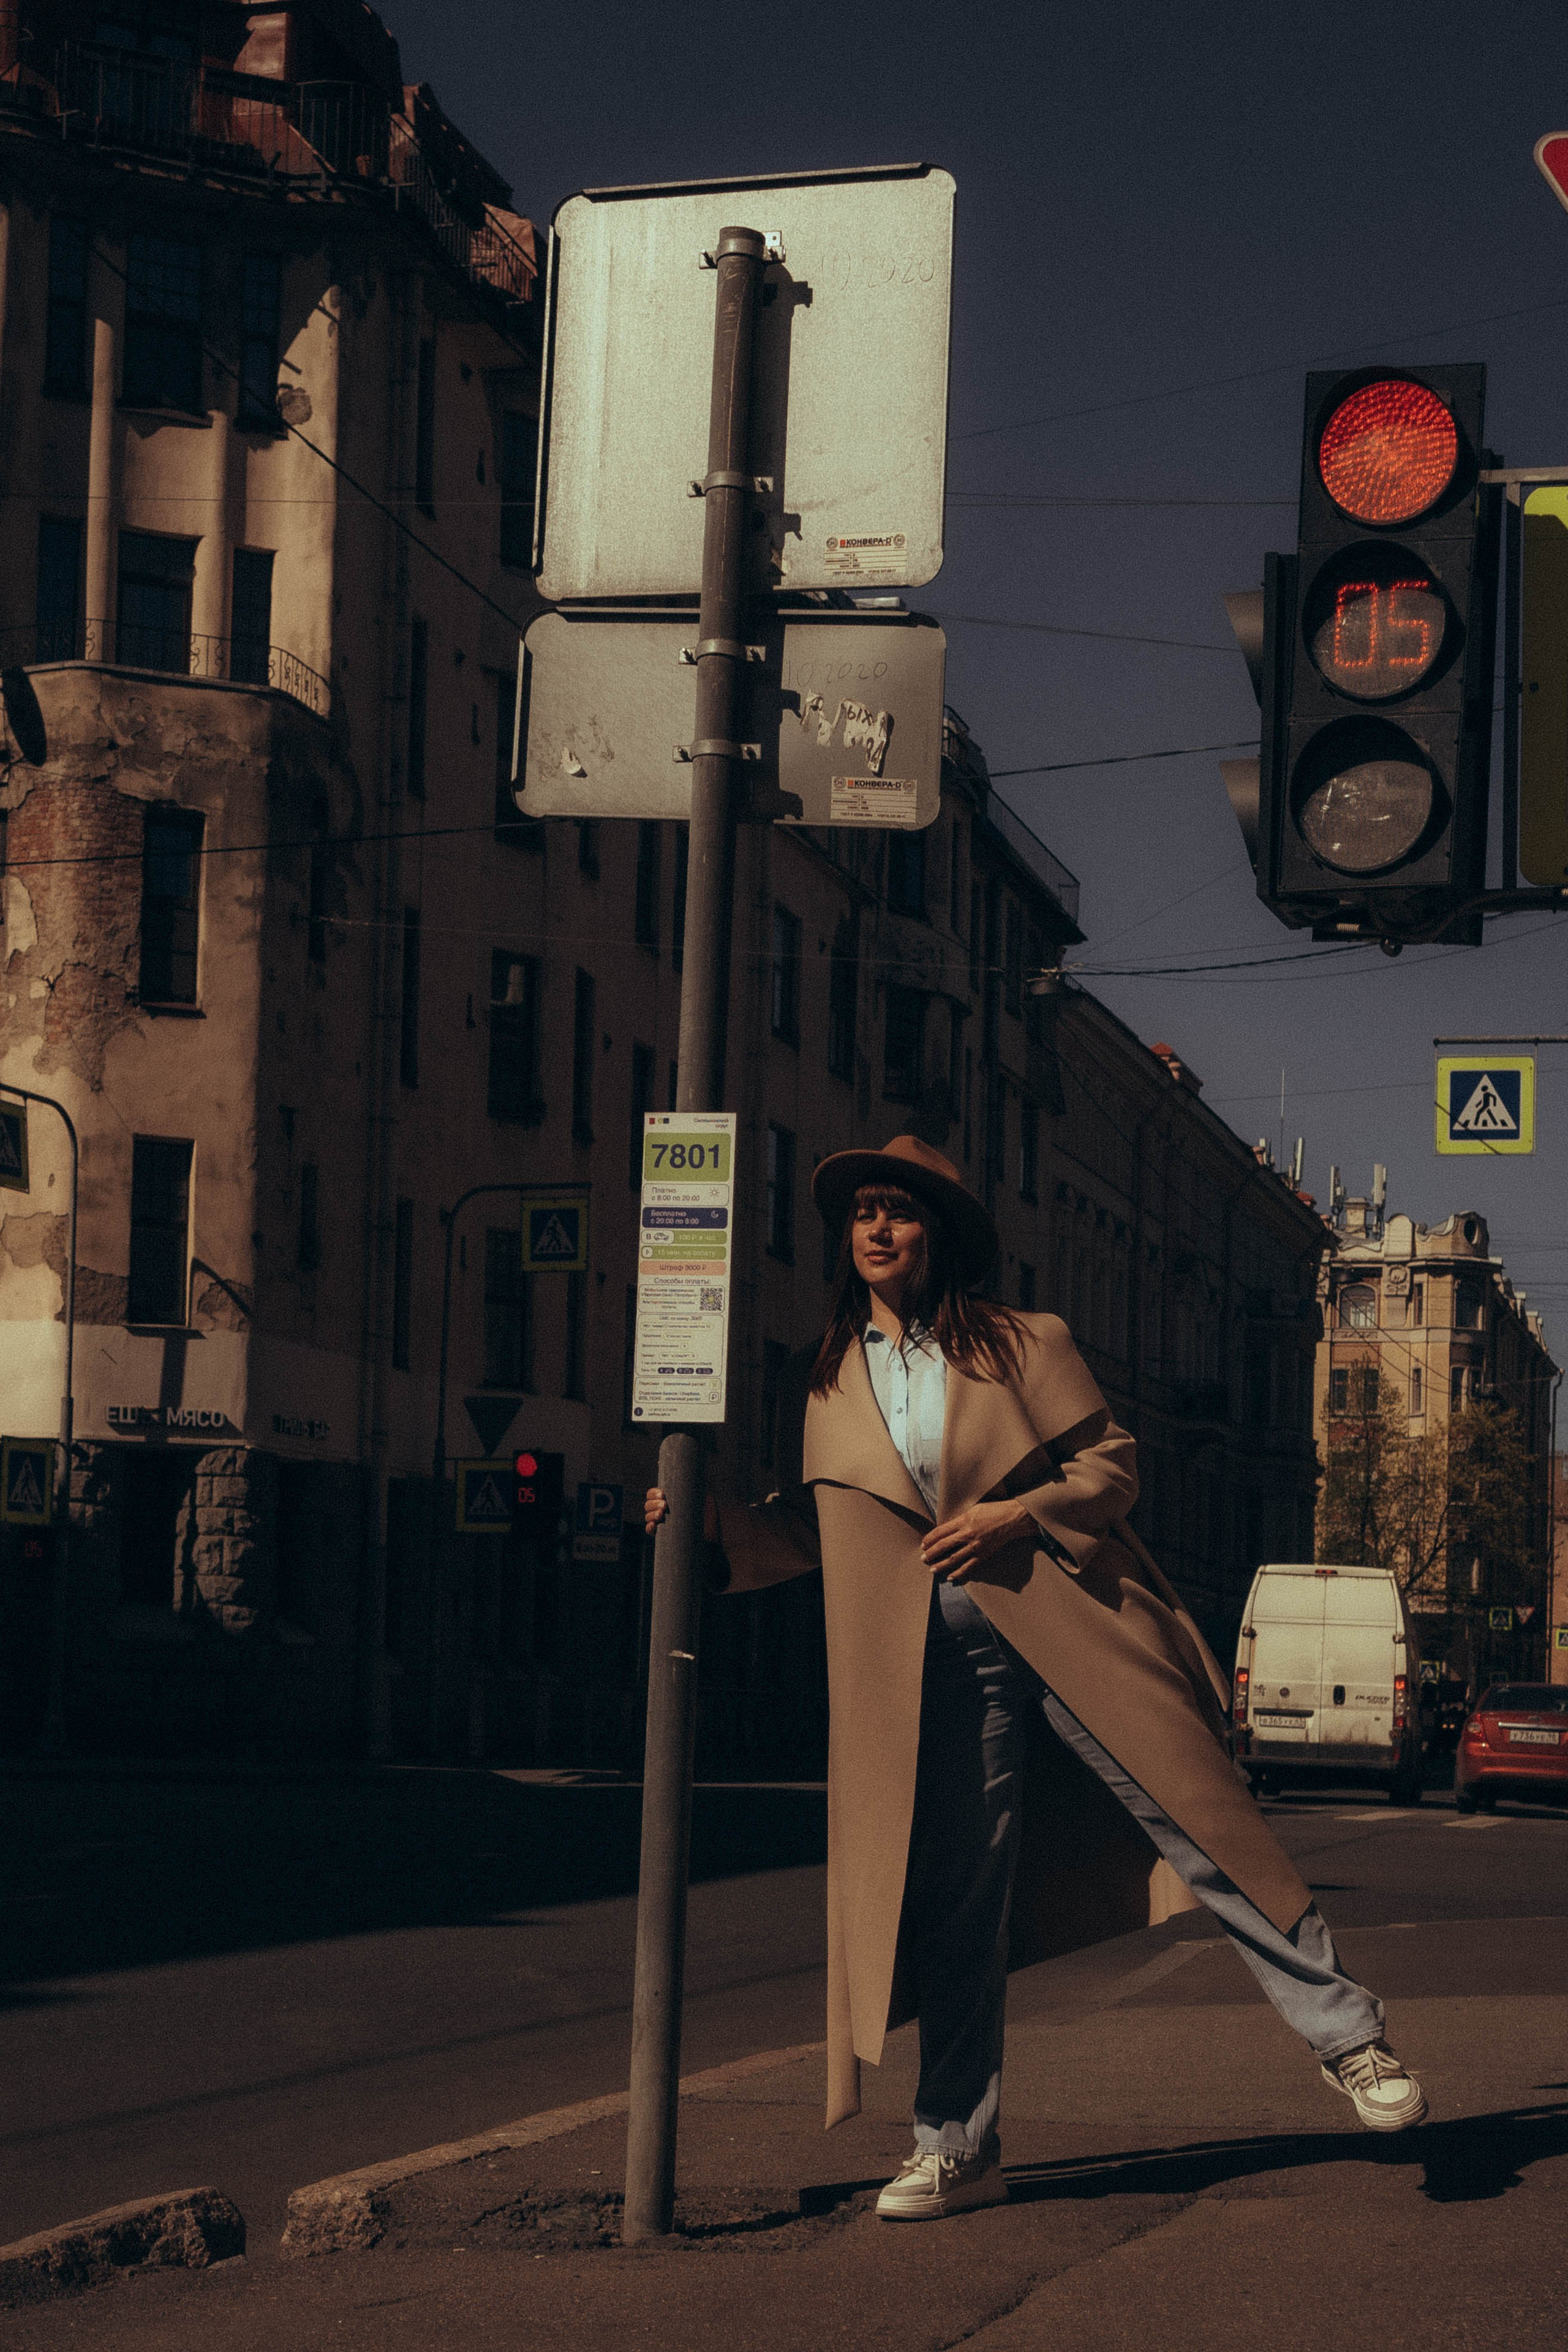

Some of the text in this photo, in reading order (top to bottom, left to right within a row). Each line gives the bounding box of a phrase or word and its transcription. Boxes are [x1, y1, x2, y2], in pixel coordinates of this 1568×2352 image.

[1333, 578, 1430, 667] 05
[651, 1144, 719, 1169] 7801
[166, 1407, 224, 1428] МЯСО
[589, 1488, 615, 1527] P
